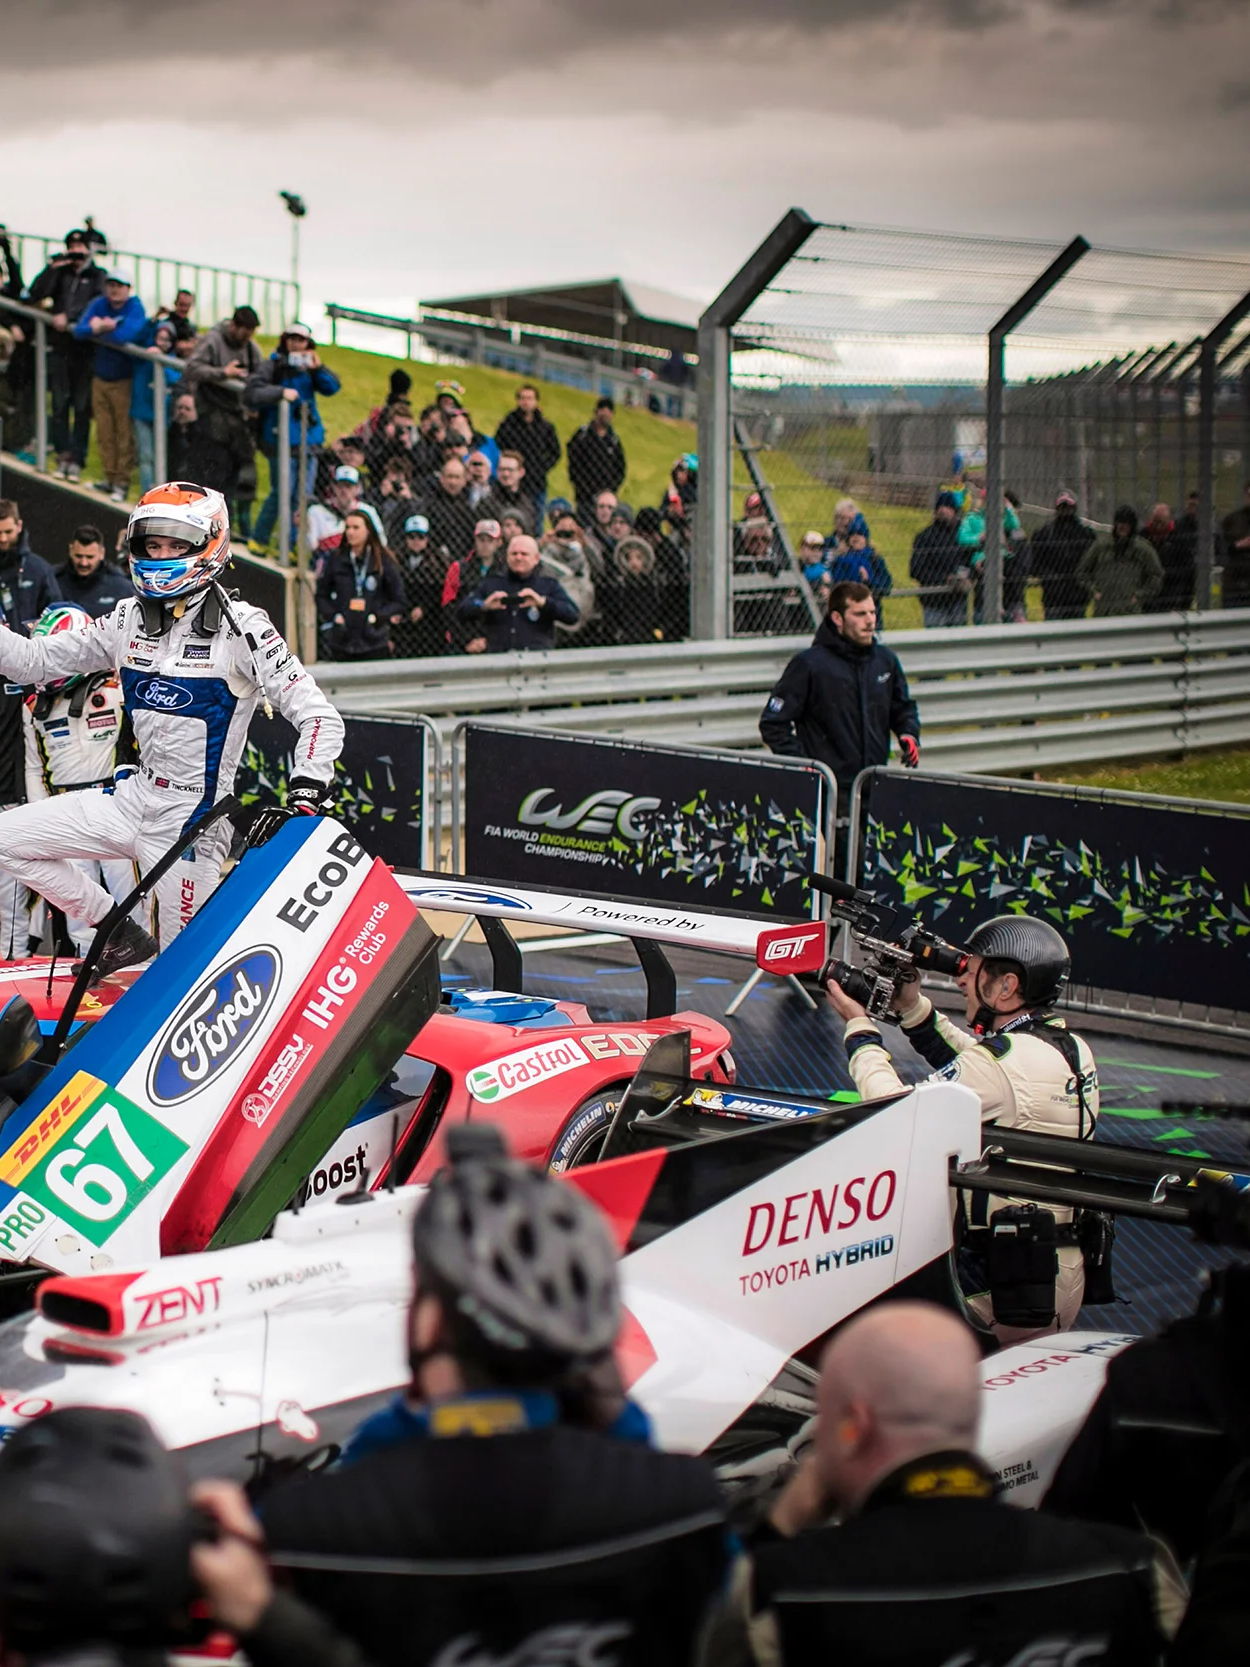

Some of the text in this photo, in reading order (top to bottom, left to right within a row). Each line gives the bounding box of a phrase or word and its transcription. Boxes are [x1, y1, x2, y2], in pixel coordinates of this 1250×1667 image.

[145, 681, 179, 707] Ford
[171, 783, 205, 794] TINCKNELL
[517, 788, 661, 840] WEC
[484, 824, 605, 853] FIA WORLD ENDURANCE
[524, 843, 604, 863] CHAMPIONSHIP
[276, 832, 366, 933] EcoB
[344, 901, 390, 958] Rewards
[577, 904, 704, 932] Powered by
[359, 931, 387, 966] Club
[764, 933, 820, 960] GT
[302, 964, 358, 1030] IHG
[171, 971, 261, 1081] Ford
[497, 1043, 582, 1089] Castrol
[13, 1094, 82, 1166] DHL
[560, 1104, 603, 1156] MICHELIN
[44, 1101, 155, 1222] 67
[741, 1169, 897, 1257] DENSO
[739, 1234, 895, 1296] TOYOTA HYBRID
[134, 1277, 223, 1330] ZENT
[1003, 1463, 1026, 1479] STEEL
[1016, 1471, 1040, 1488] METAL
